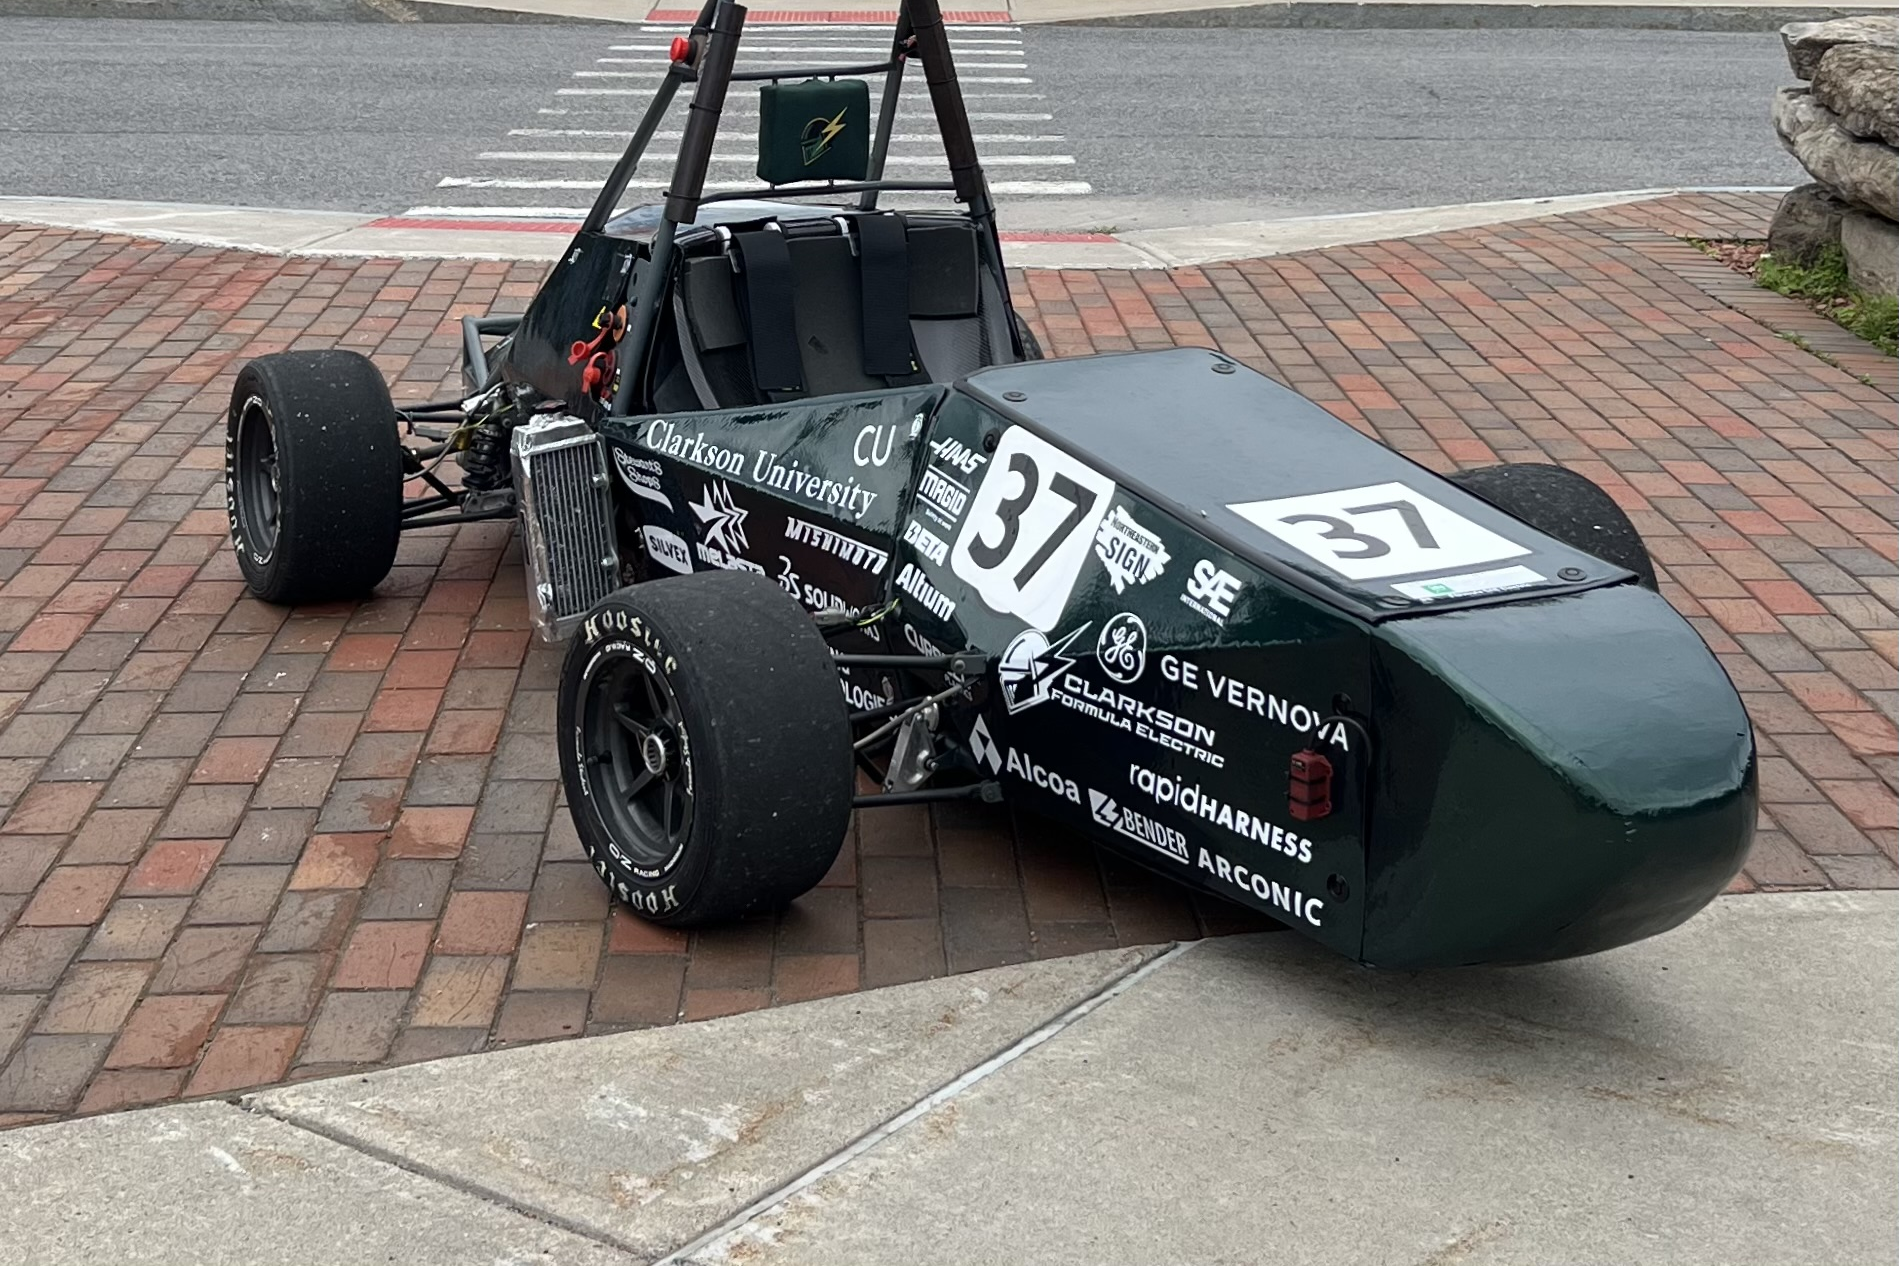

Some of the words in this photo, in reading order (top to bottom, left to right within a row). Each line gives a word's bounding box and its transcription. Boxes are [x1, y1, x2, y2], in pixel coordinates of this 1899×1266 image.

[645, 418, 745, 476] Clarkson
[752, 449, 878, 520] University
[853, 424, 897, 467] CU
[929, 436, 988, 475] HAAS
[918, 469, 968, 516] MAGID
[649, 534, 689, 566] SILVEX
[784, 516, 889, 575] MISHIMOTO
[903, 519, 950, 567] BETA
[967, 452, 1098, 593] 37
[1276, 499, 1441, 560] 37
[1105, 536, 1150, 579] SIGN
[895, 562, 956, 622] Altium
[1187, 559, 1242, 618] SAE
[1050, 687, 1132, 732] FORMULA
[1134, 721, 1225, 768] ELECTRIC
[1063, 673, 1216, 747] CLARKSON
[1160, 654, 1200, 691] GE
[1206, 669, 1348, 752] VERNOVA
[1006, 746, 1081, 805] Alcoa
[1122, 806, 1189, 859] BENDER
[1129, 763, 1313, 864] rapidHARNESS
[633, 866, 660, 878] RACING
[1197, 846, 1325, 927] ARCONIC
